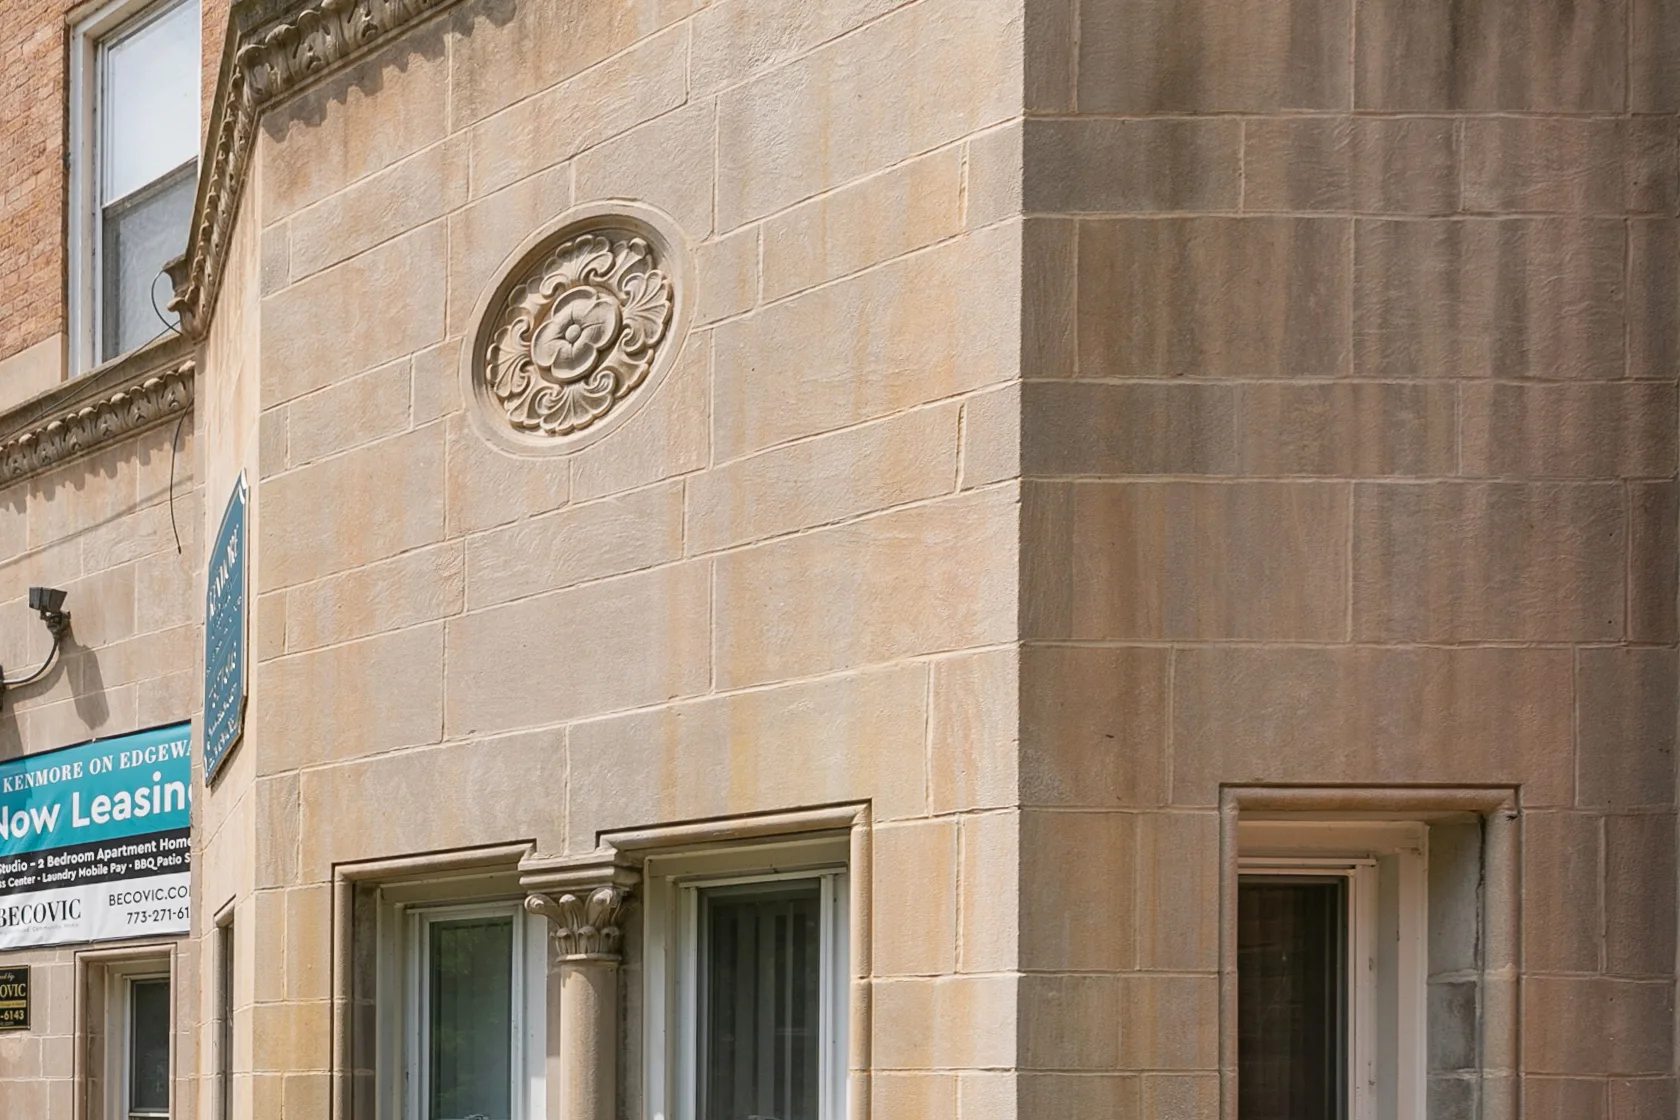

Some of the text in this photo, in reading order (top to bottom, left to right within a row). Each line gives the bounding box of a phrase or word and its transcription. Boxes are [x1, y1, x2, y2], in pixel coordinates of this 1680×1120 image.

[3, 761, 83, 793] KENMORE
[89, 754, 114, 775] ON
[72, 771, 192, 828] Leasin
[8, 875, 35, 887] Center
[42, 868, 76, 882] Laundry
[78, 863, 108, 877] Mobile
[110, 863, 127, 874] Pay
[134, 857, 158, 871] BBQ
[157, 853, 182, 867] Patio
[37, 858, 45, 869] 2
[47, 851, 94, 867] Bedroom
[97, 840, 157, 861] Apartment
[109, 885, 191, 906] BECOVIC.CO
